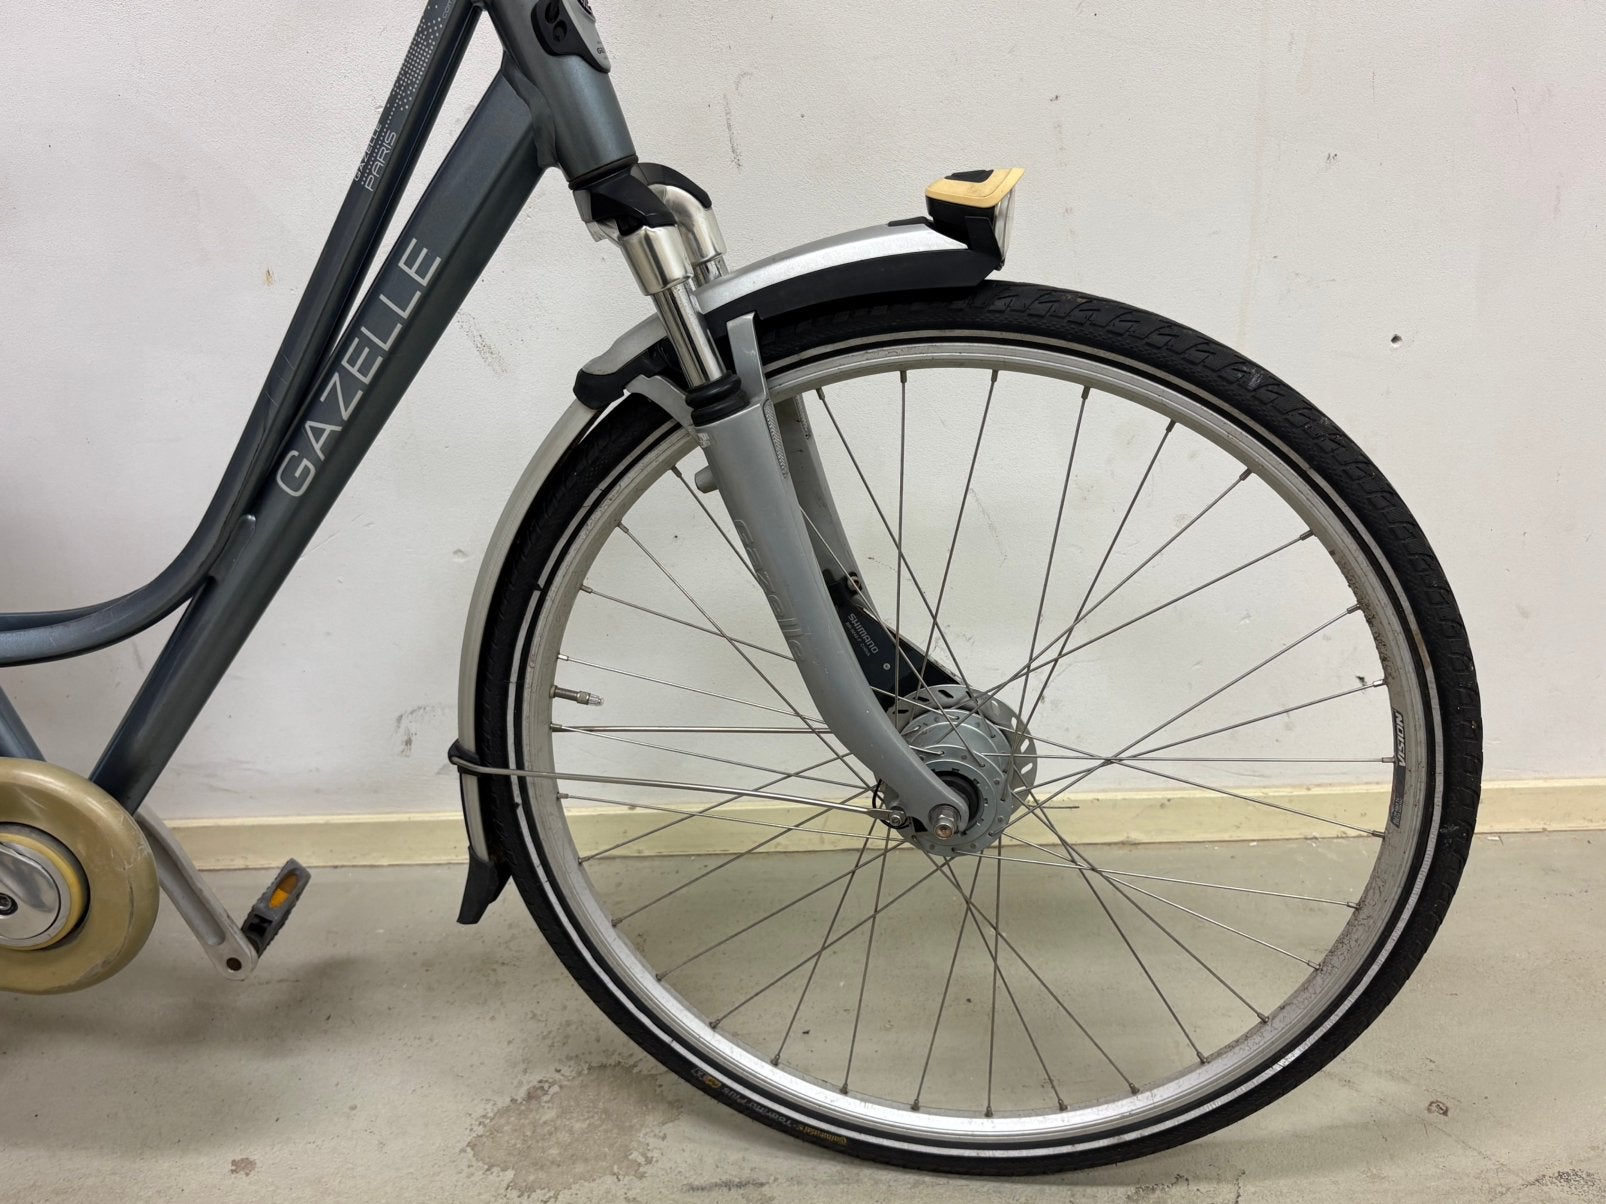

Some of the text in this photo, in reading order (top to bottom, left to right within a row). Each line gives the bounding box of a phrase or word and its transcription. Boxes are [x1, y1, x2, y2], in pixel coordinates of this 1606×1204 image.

[364, 129, 397, 192] PARIS
[276, 237, 442, 497] GAZELLE
[847, 613, 879, 654] SHIMANO
[1395, 711, 1406, 767] VISION
